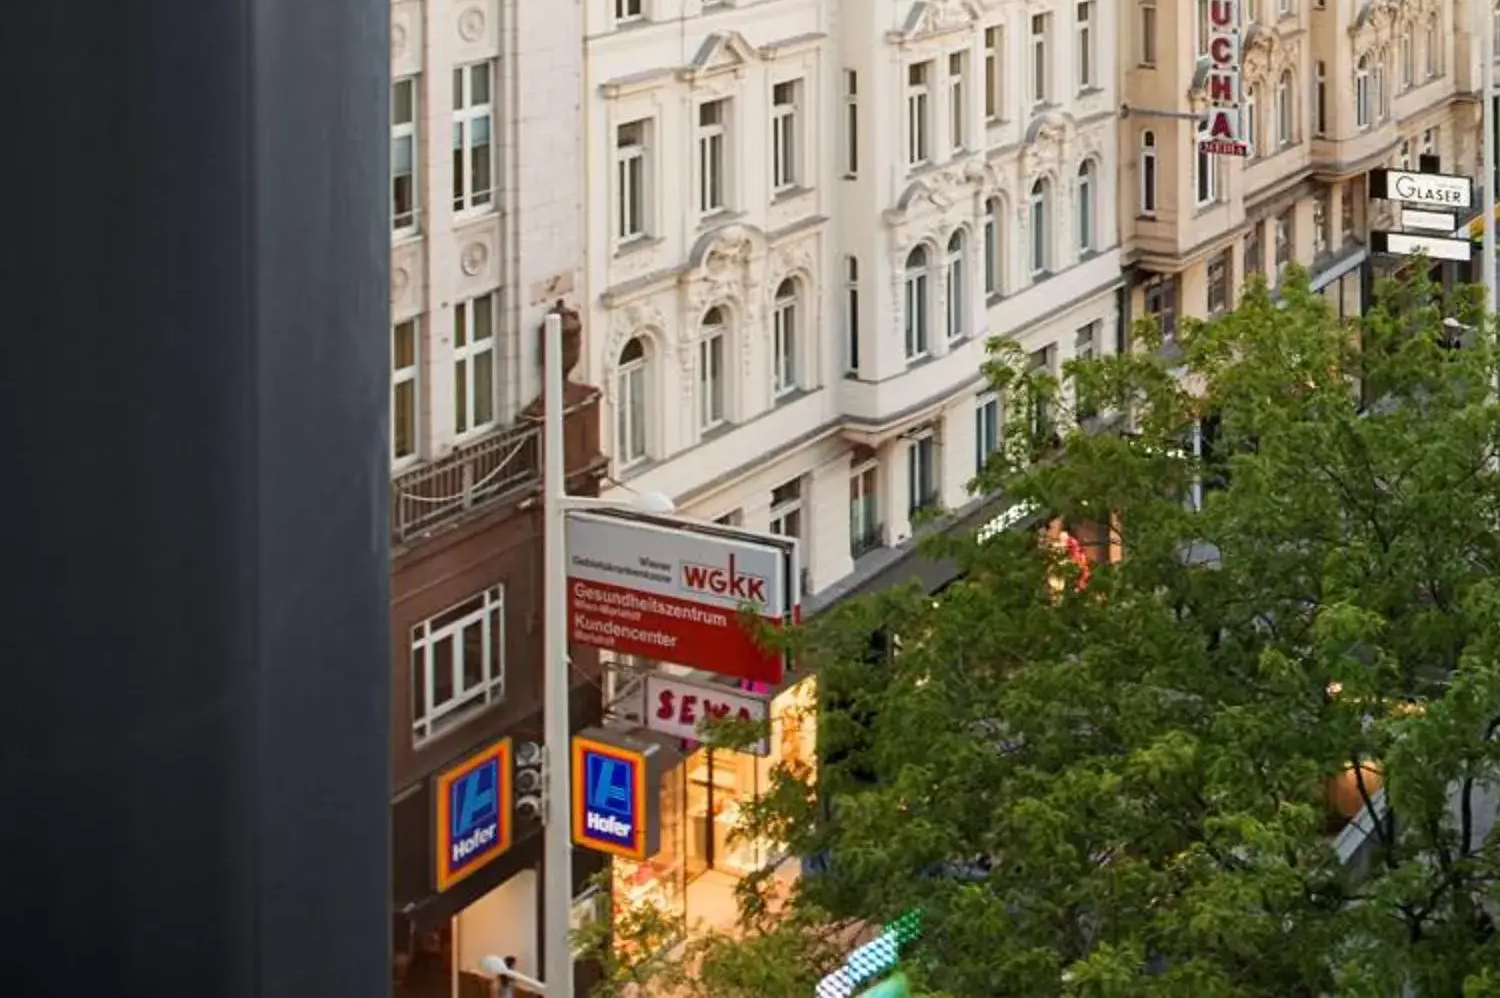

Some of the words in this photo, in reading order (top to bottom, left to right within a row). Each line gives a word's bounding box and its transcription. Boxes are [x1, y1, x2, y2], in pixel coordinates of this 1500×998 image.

[1396, 175, 1461, 203] GLASER
[574, 583, 727, 627] Gesundheitszentrum
[574, 613, 678, 647] Kundencenter
[587, 811, 632, 838] Hofer
[453, 822, 497, 862] Hofer
